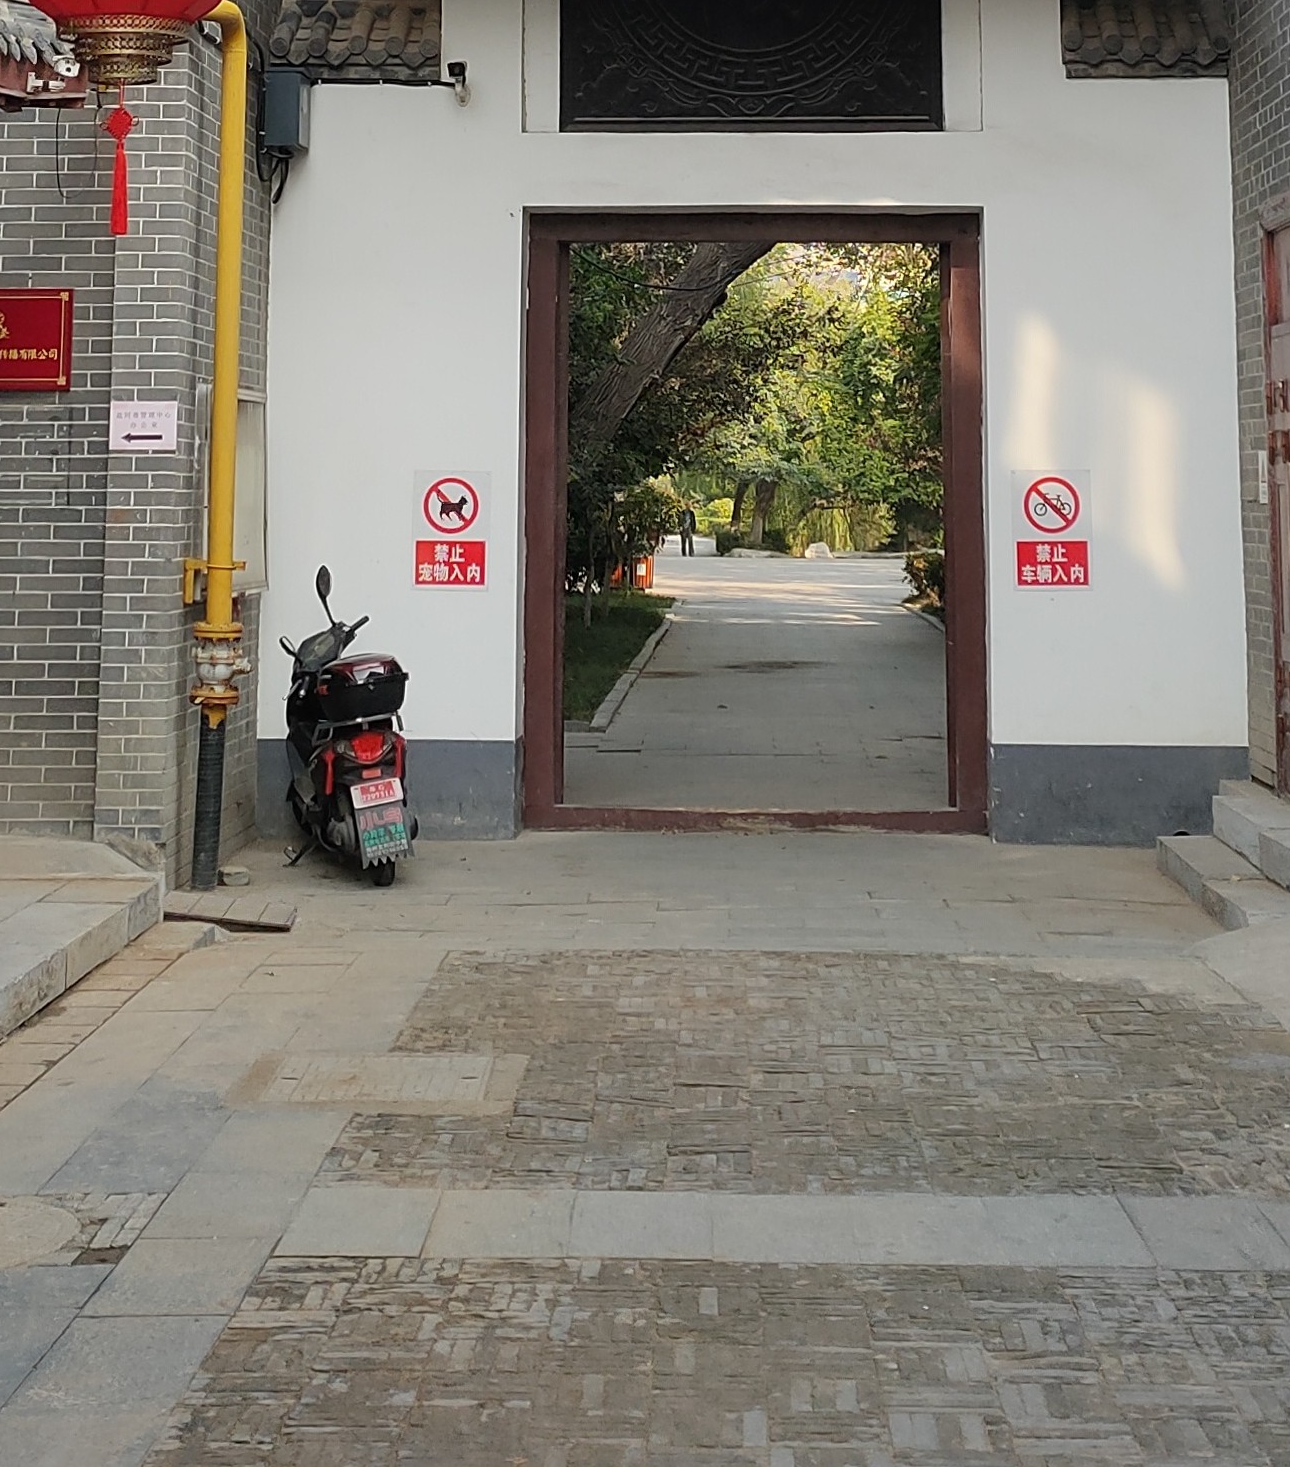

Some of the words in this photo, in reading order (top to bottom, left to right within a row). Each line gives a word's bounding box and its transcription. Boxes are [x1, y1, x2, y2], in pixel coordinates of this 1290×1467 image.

[434, 543, 466, 563] 禁止
[1036, 543, 1068, 563] 禁止
[418, 562, 481, 583] 宠物入内
[1021, 563, 1085, 584] 车辆入内
